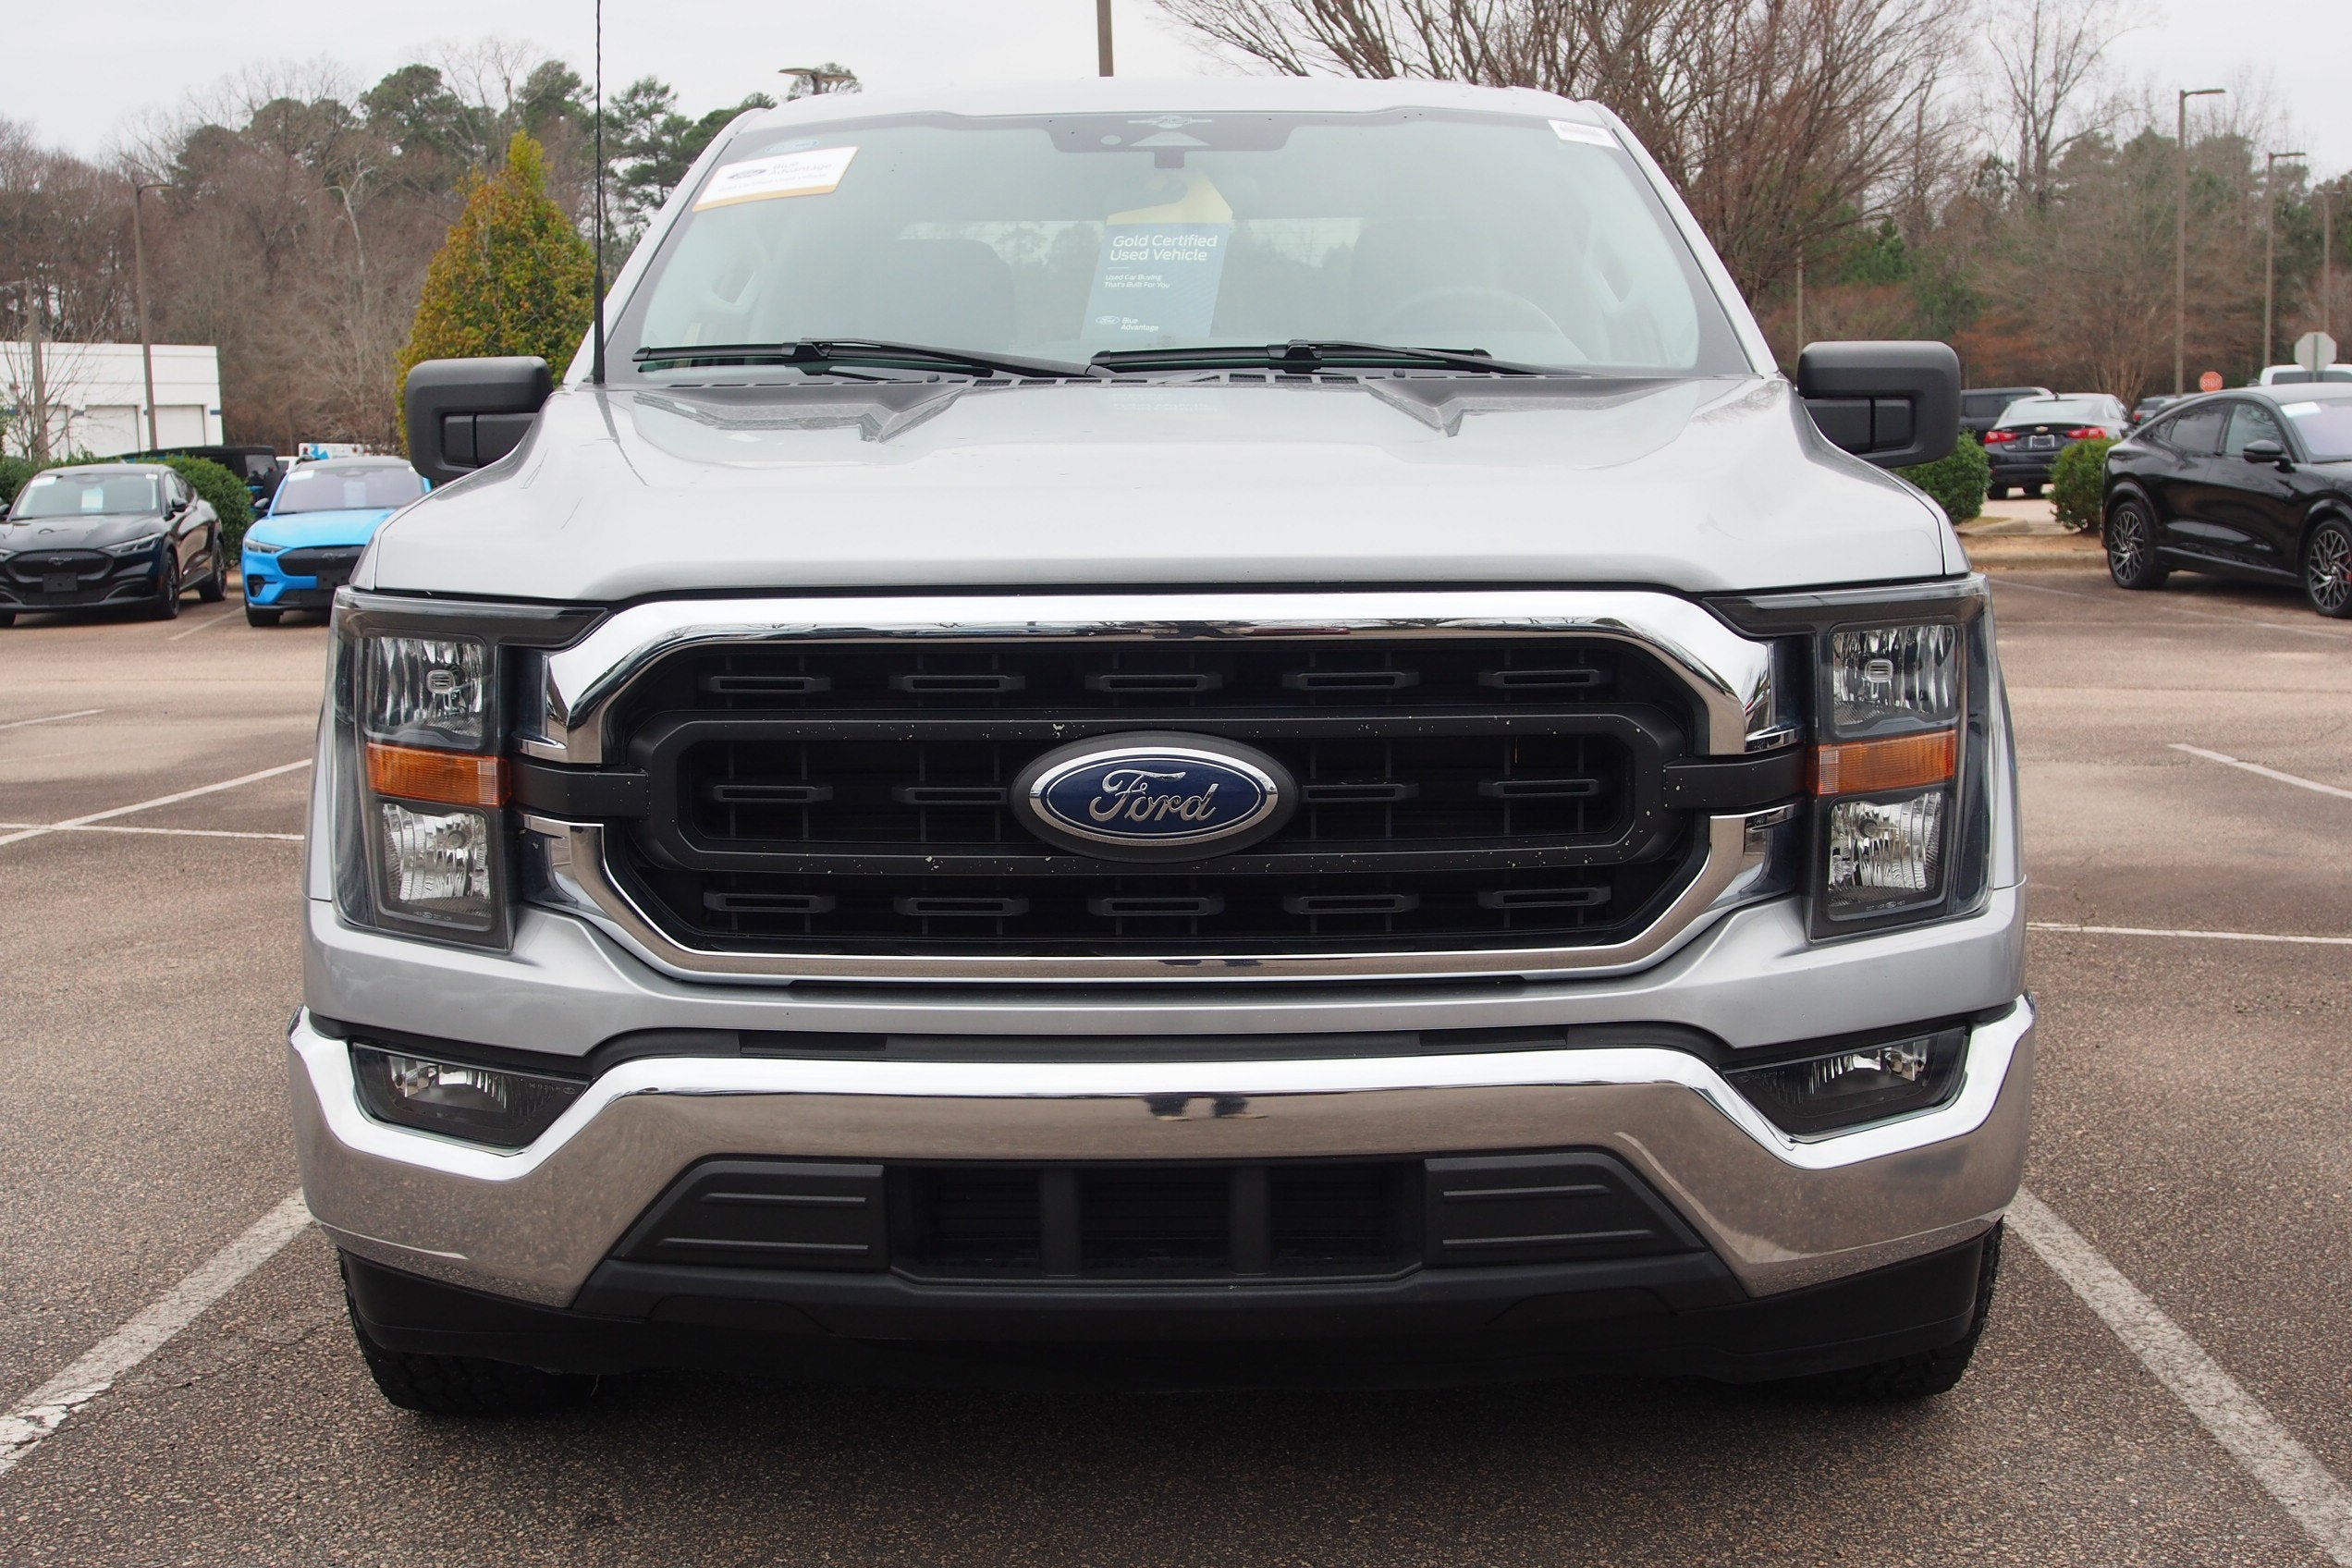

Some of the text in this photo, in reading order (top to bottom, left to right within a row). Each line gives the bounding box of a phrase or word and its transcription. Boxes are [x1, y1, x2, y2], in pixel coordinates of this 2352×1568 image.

[1113, 234, 1218, 247] Gold Certified
[1109, 249, 1207, 261] Used Vehicle
[1121, 324, 1159, 332] Advantage
[1089, 769, 1219, 822] Ford
